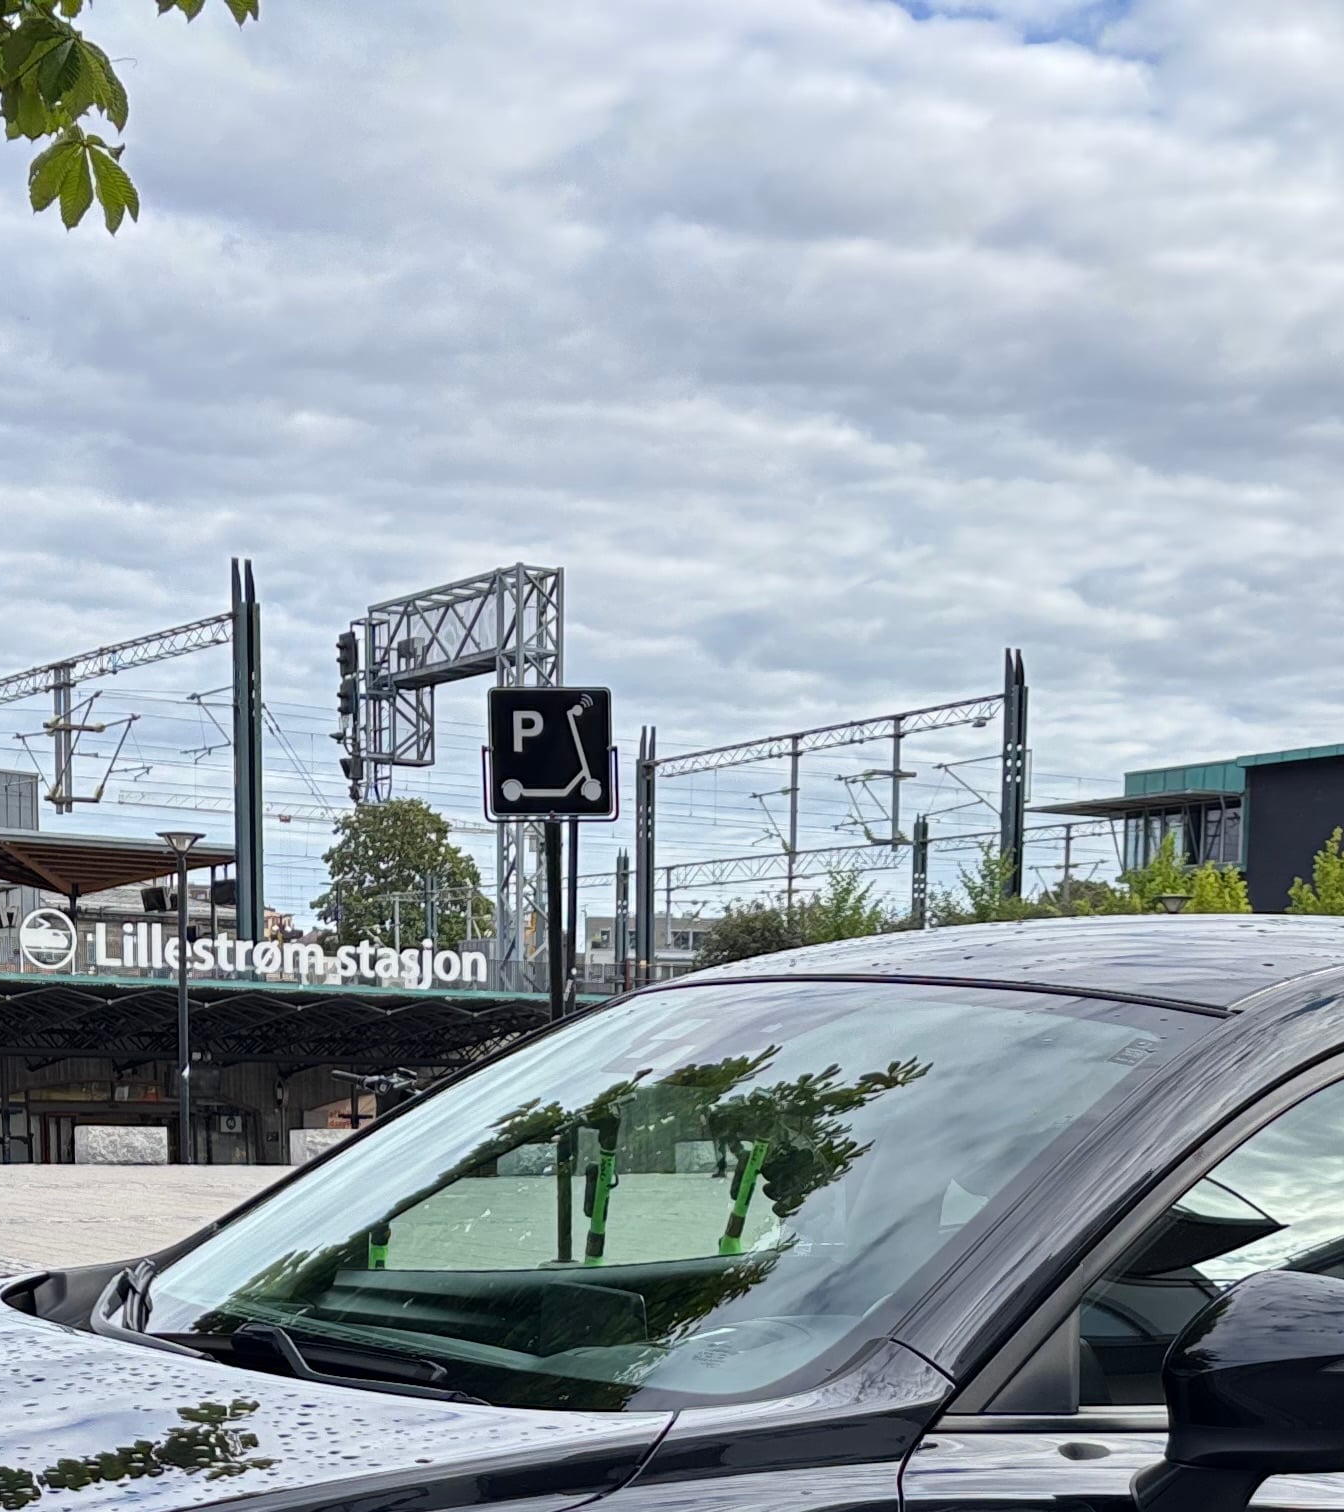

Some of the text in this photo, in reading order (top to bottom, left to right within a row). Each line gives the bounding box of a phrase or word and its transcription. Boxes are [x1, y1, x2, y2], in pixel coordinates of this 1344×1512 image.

[512, 710, 544, 752] P
[95, 921, 488, 990] Lillestrøm stasjon
